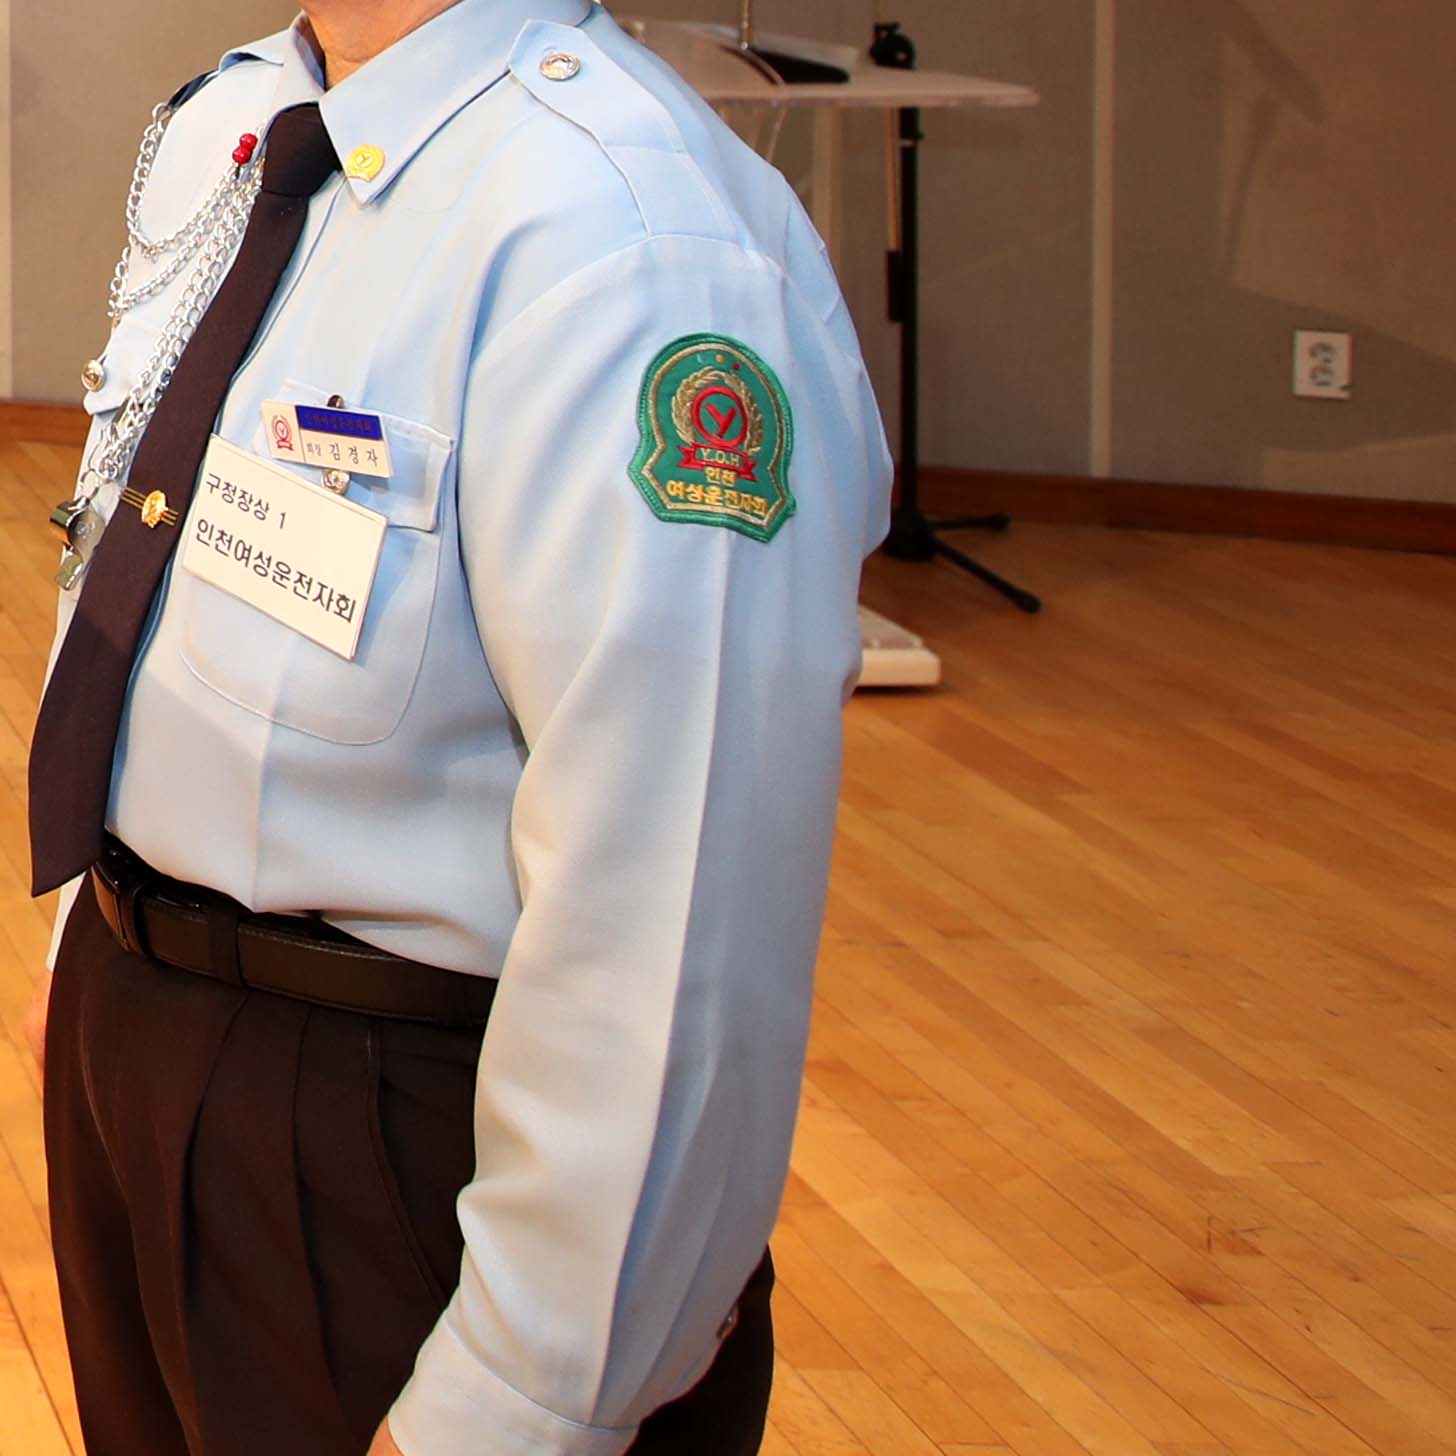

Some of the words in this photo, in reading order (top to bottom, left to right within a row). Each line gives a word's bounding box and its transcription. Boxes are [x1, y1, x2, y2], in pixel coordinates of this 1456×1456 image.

[205, 472, 270, 521] 구청장상
[279, 512, 287, 530] 1
[704, 465, 737, 487] 인천
[196, 518, 357, 624] 인천여성운전자회
